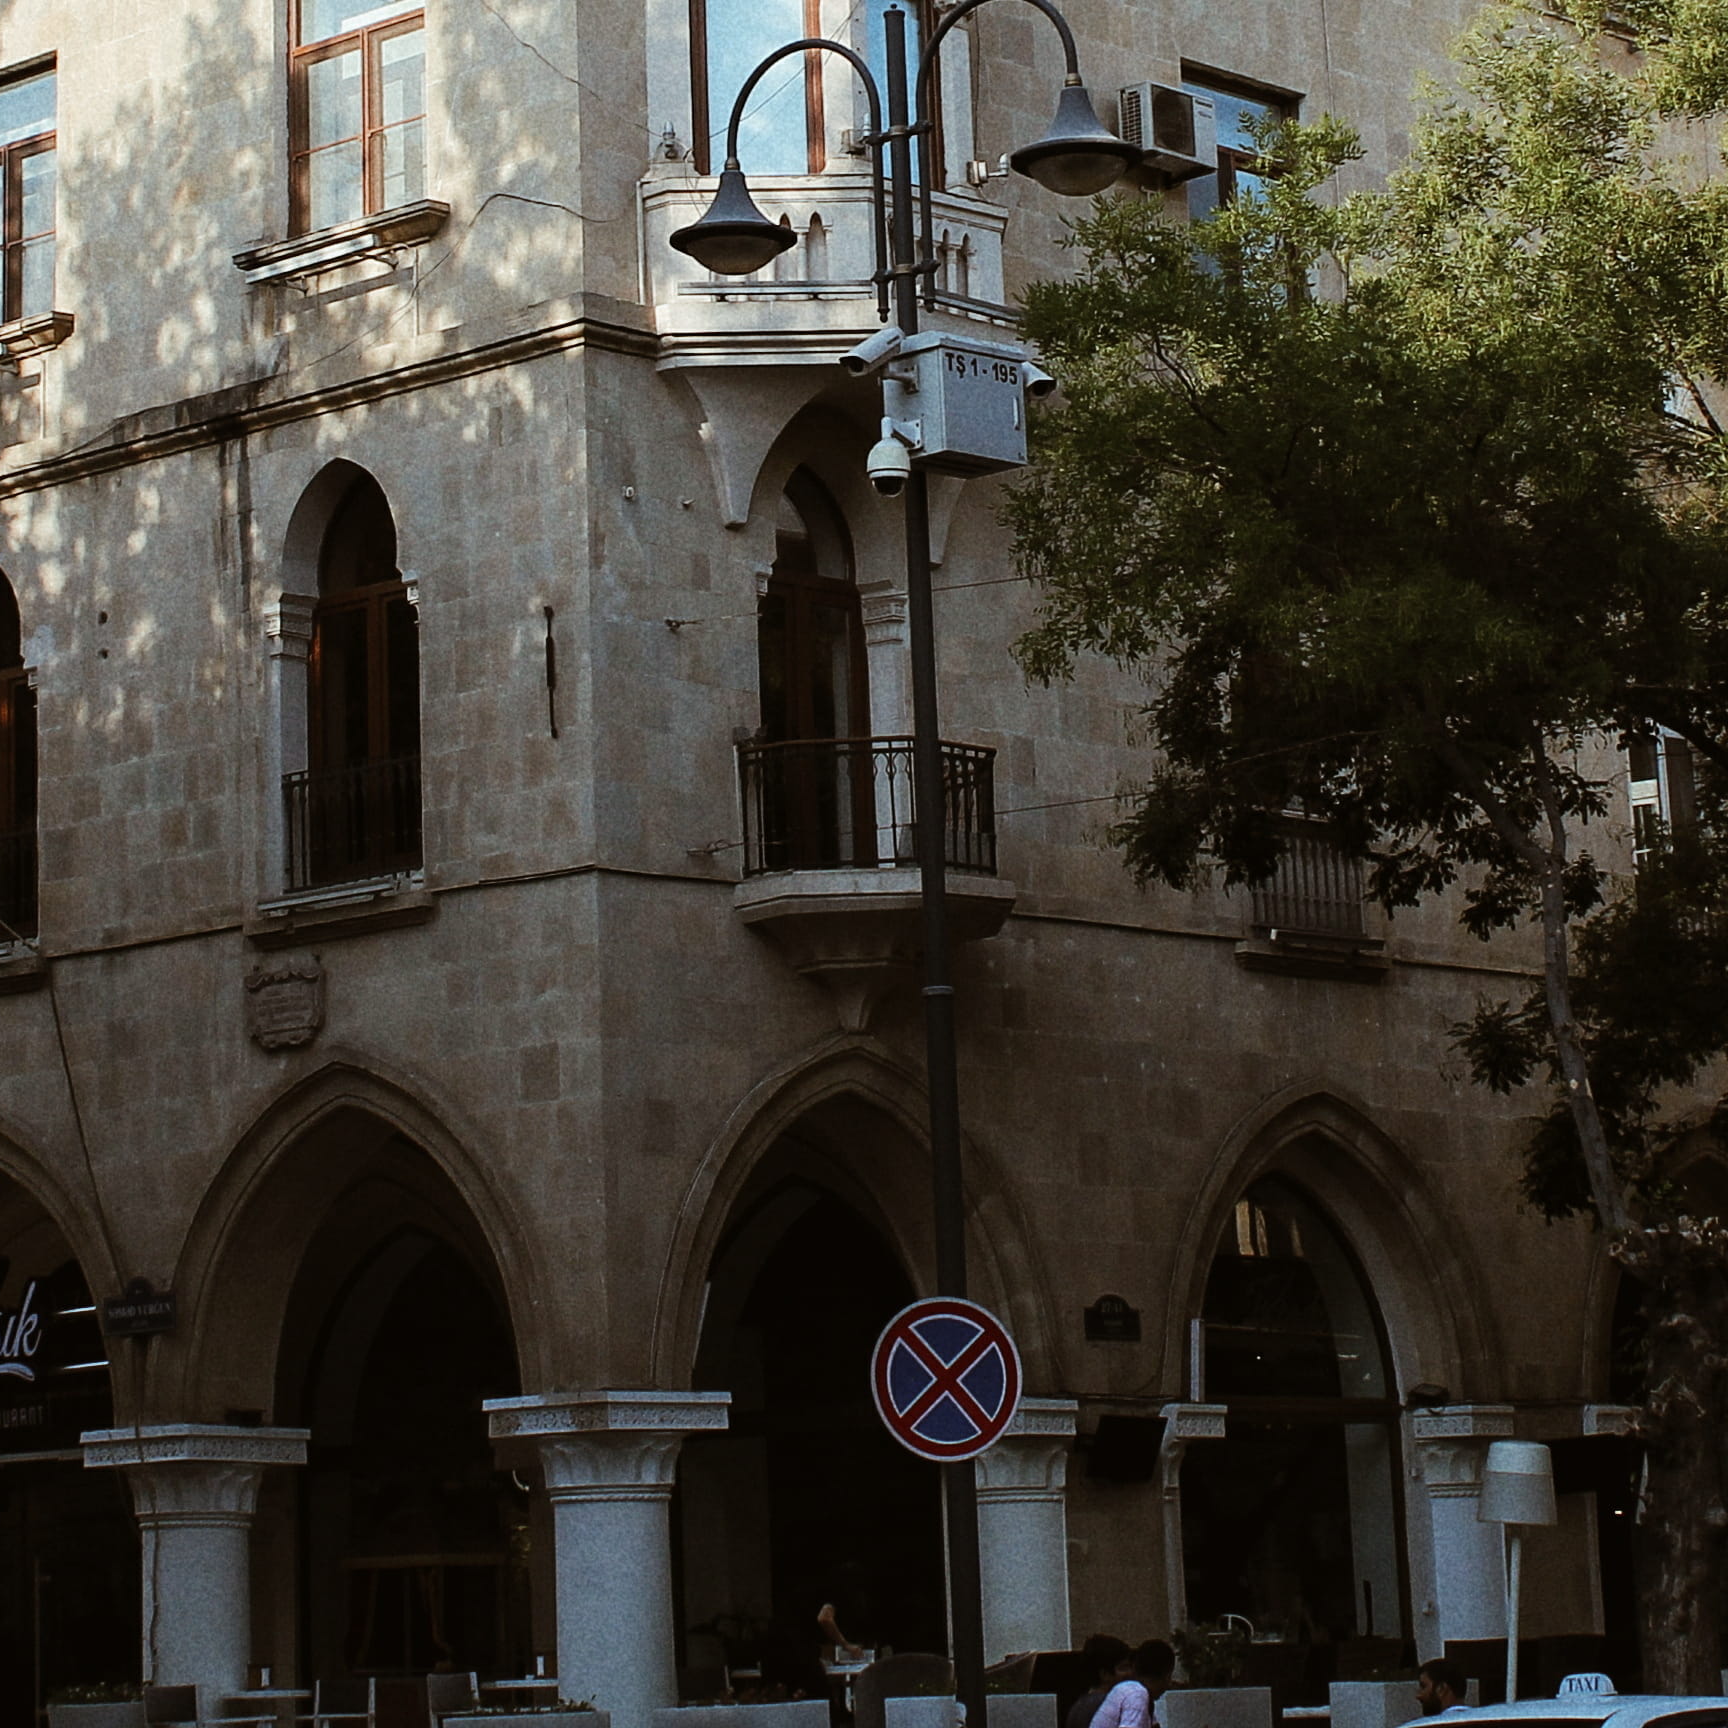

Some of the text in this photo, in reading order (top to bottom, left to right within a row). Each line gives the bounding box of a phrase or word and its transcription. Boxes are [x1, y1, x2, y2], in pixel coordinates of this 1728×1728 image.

[945, 353, 966, 379] TŞ
[992, 363, 1018, 385] 195
[1567, 1676, 1600, 1692] TAXI
